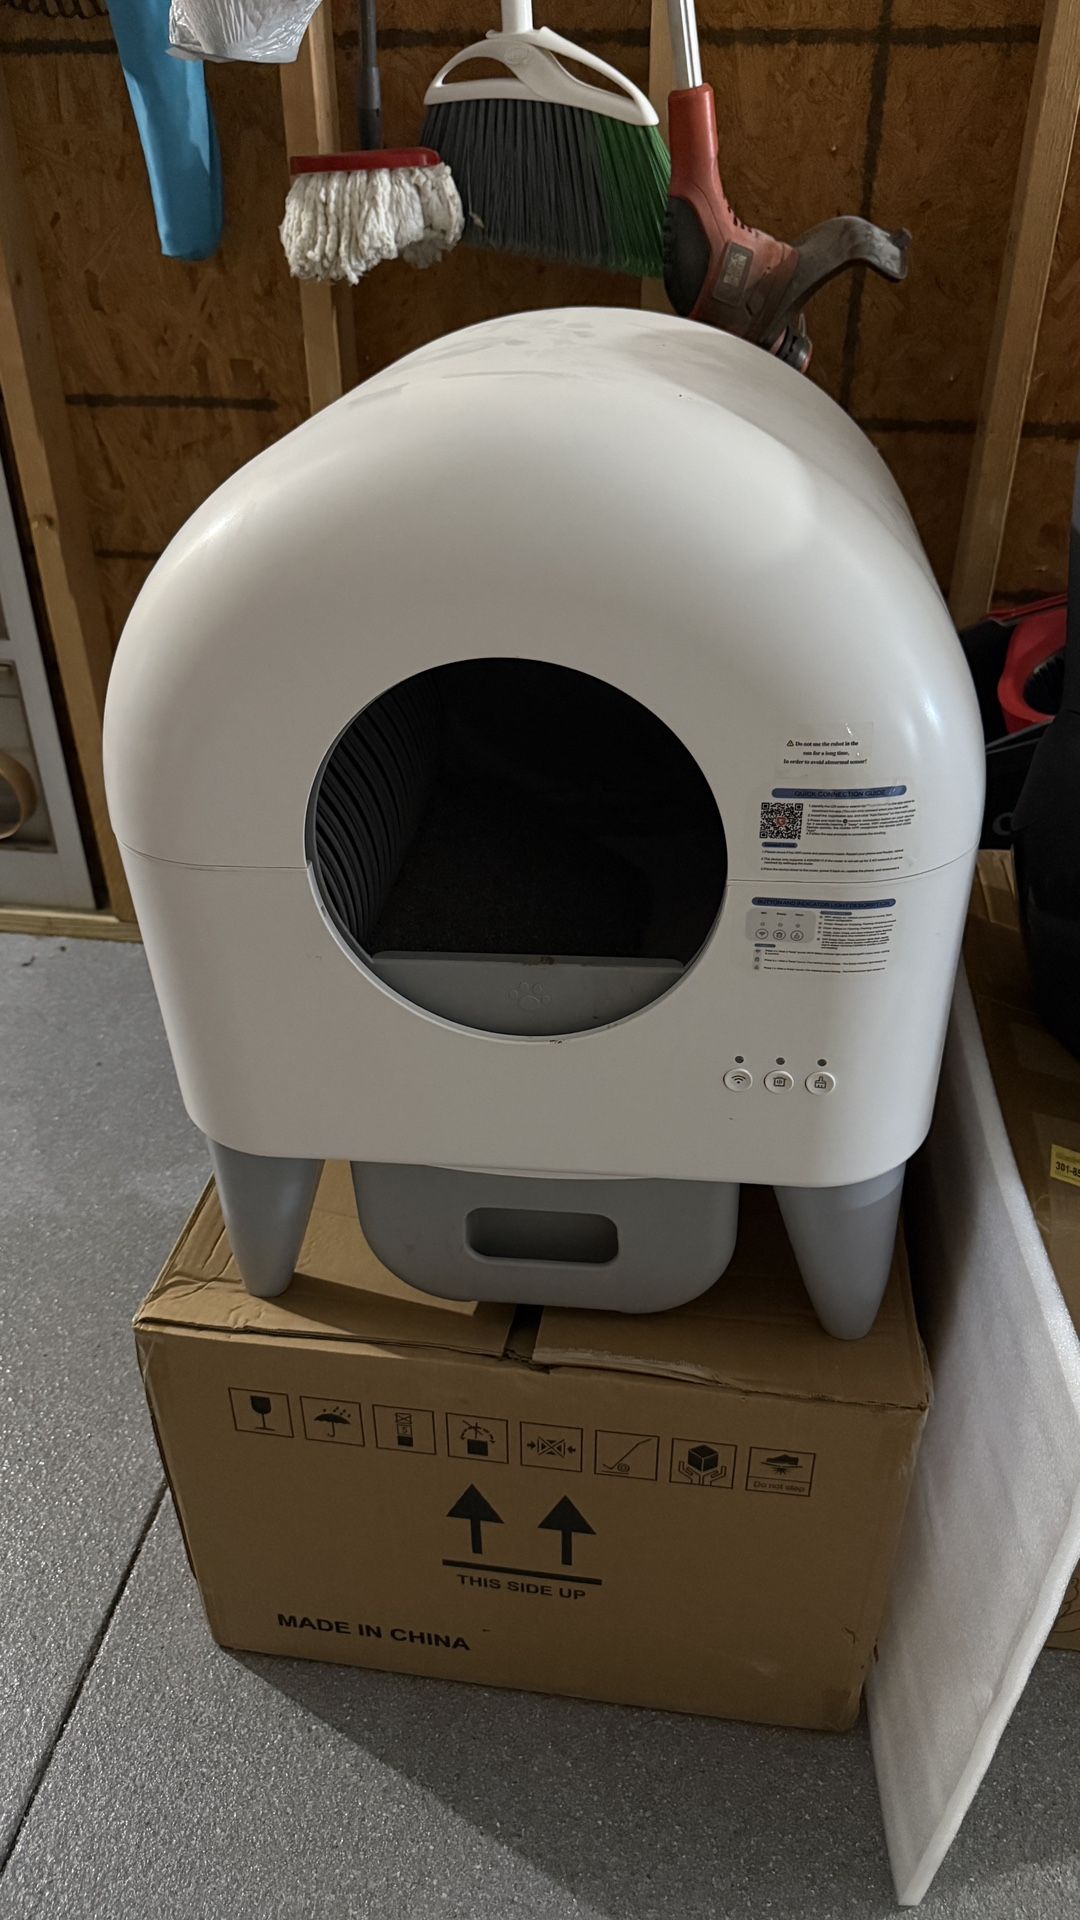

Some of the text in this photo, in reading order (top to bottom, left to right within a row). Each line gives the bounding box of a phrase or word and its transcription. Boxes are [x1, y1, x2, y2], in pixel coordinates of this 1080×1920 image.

[456, 1574, 586, 1600] THIS SIDE UP
[277, 1613, 471, 1651] MADE IN CHINA
